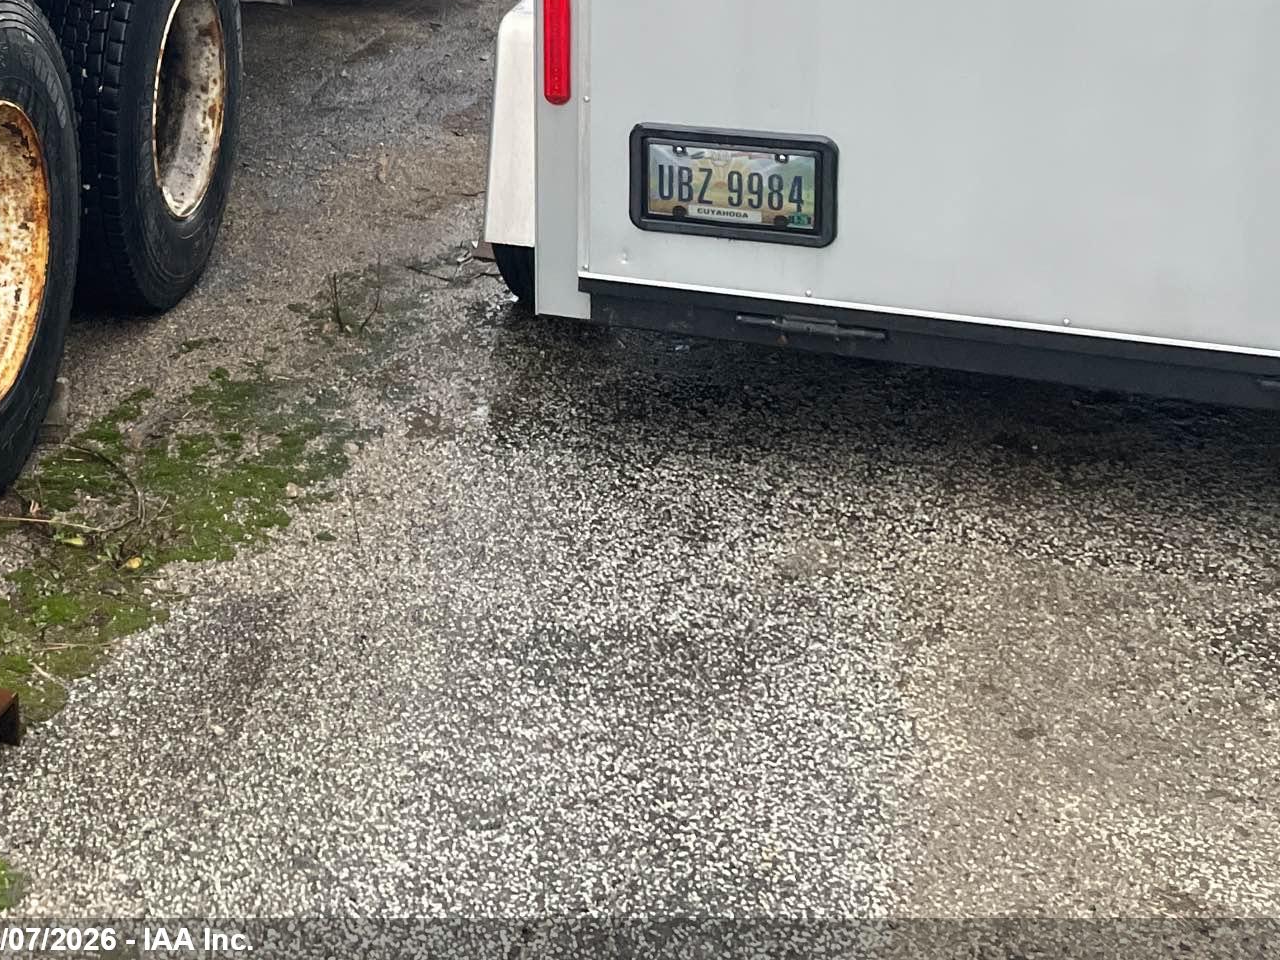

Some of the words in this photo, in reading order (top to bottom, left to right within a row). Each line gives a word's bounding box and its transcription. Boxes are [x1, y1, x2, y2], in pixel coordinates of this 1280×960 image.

[658, 164, 713, 205] UBZ
[726, 170, 805, 213] 9984
[696, 207, 750, 219] CUYAHOGA
